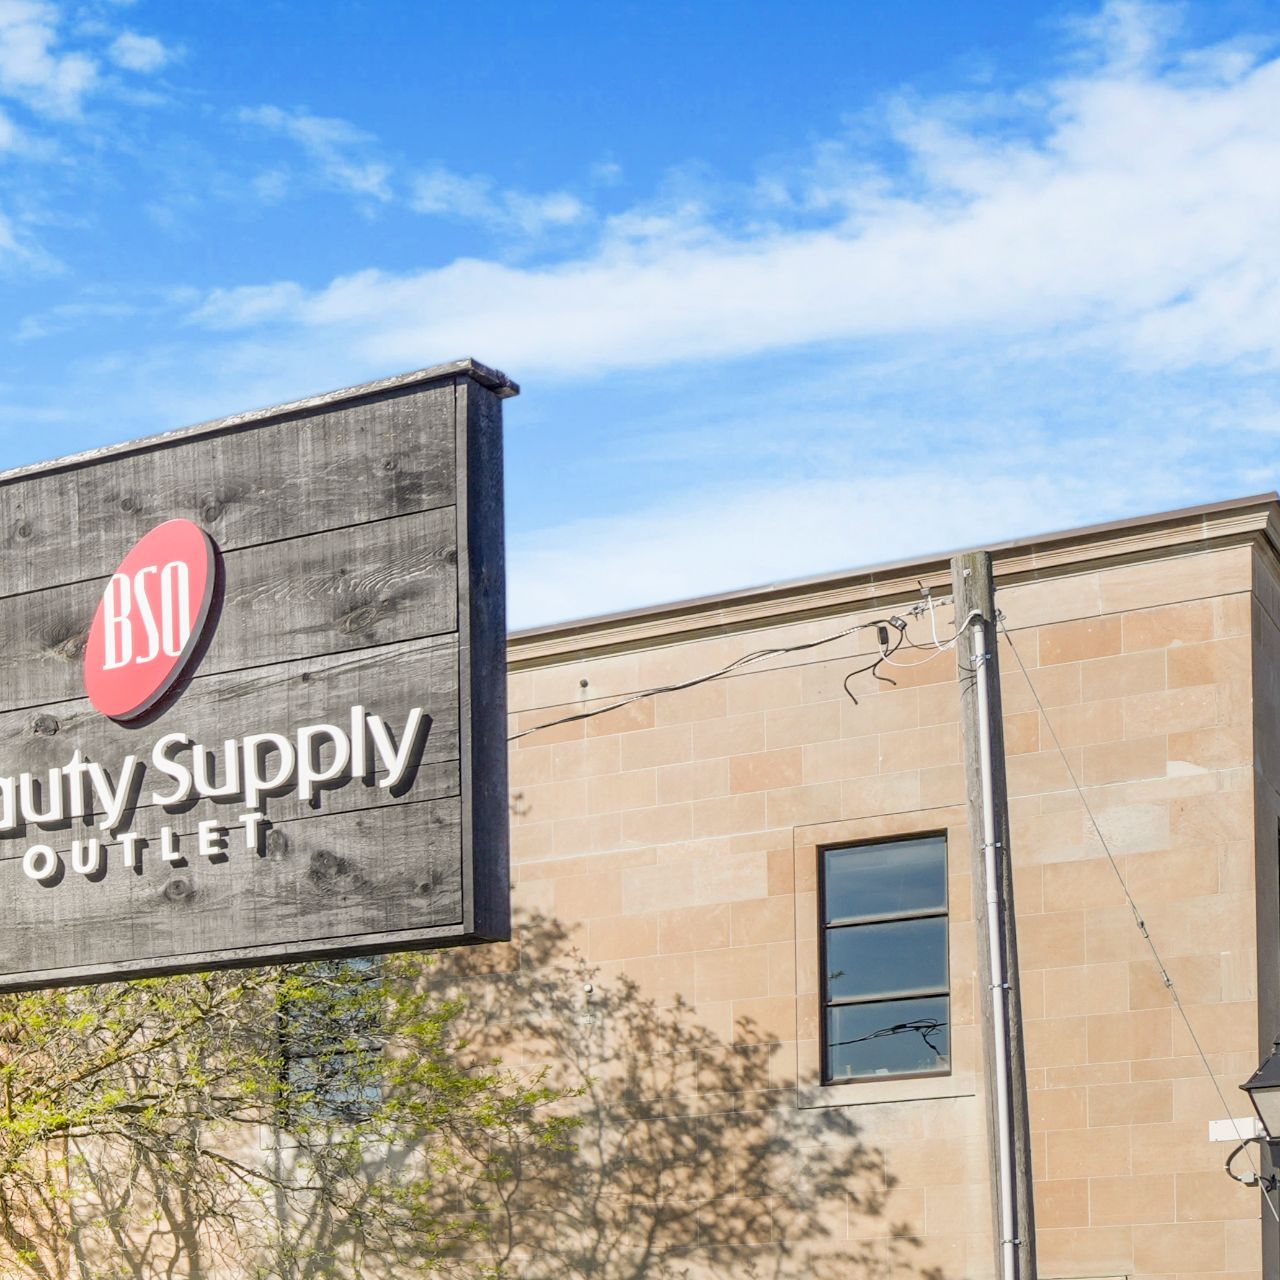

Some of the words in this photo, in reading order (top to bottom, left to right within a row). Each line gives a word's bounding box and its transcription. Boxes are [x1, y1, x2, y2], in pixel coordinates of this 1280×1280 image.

[102, 560, 190, 671] BSO
[152, 705, 423, 807] Supply
[22, 812, 263, 880] OUTLET
